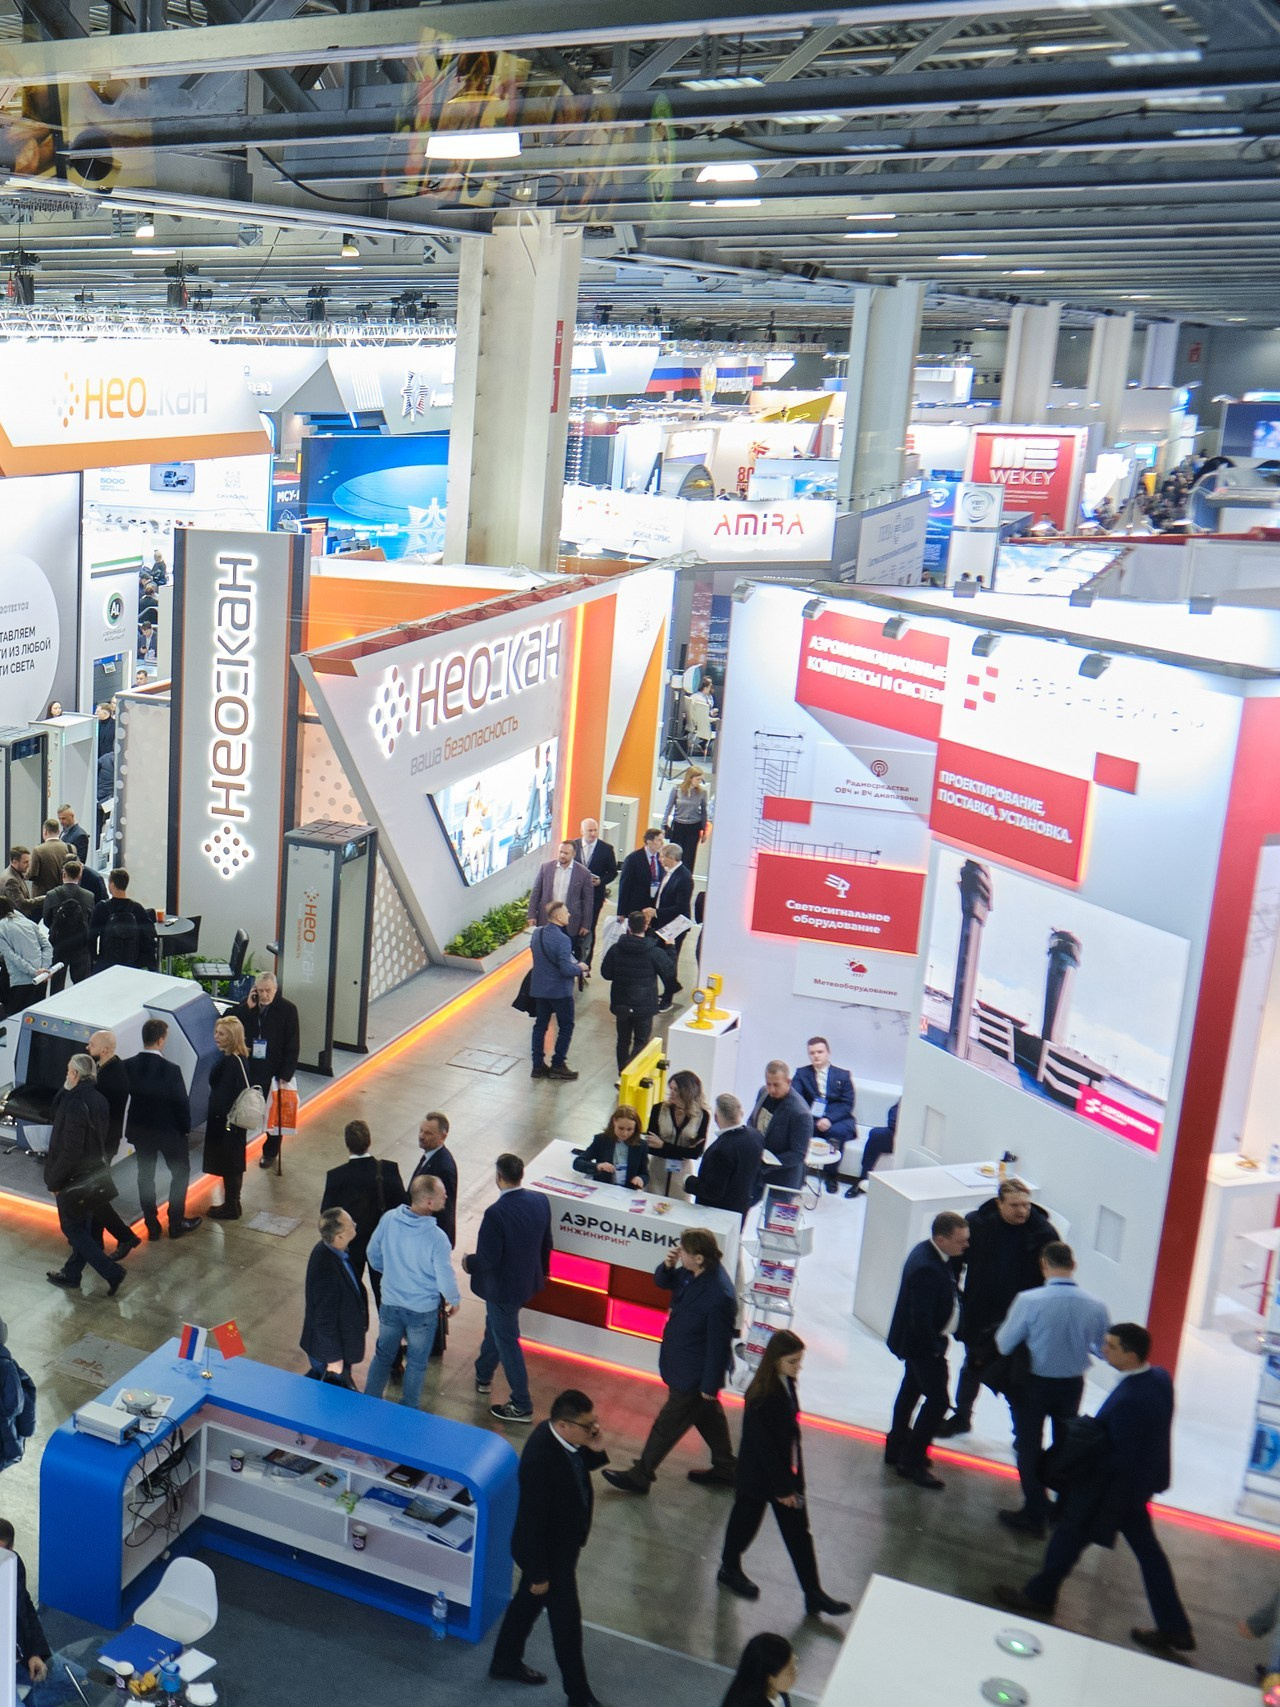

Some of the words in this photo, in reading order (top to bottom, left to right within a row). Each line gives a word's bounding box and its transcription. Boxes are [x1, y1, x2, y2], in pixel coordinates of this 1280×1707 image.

[989, 469, 1056, 485] WEKEY
[9, 645, 20, 658] ИЗ
[21, 637, 51, 656] ЛЮБОЙ
[10, 658, 35, 674] СВЕТА
[443, 715, 519, 761] безопасность
[835, 786, 853, 796] ОВЧ
[861, 789, 872, 798] ВЧ
[873, 792, 919, 802] диапазона
[846, 779, 910, 793] Радиосредства
[939, 770, 1046, 816] ПРОЕКТИРОВАНИЕ,
[937, 788, 998, 821] ПОСТАВКА,
[998, 808, 1073, 843] УСТАНОВКА.
[785, 899, 891, 923] Светосигнальное
[792, 914, 881, 935] оборудование
[813, 977, 899, 997] Метеооборудование
[559, 1224, 632, 1247] ИНЖИНИРИНГ
[560, 1211, 681, 1248] АЭРОНАВИК
